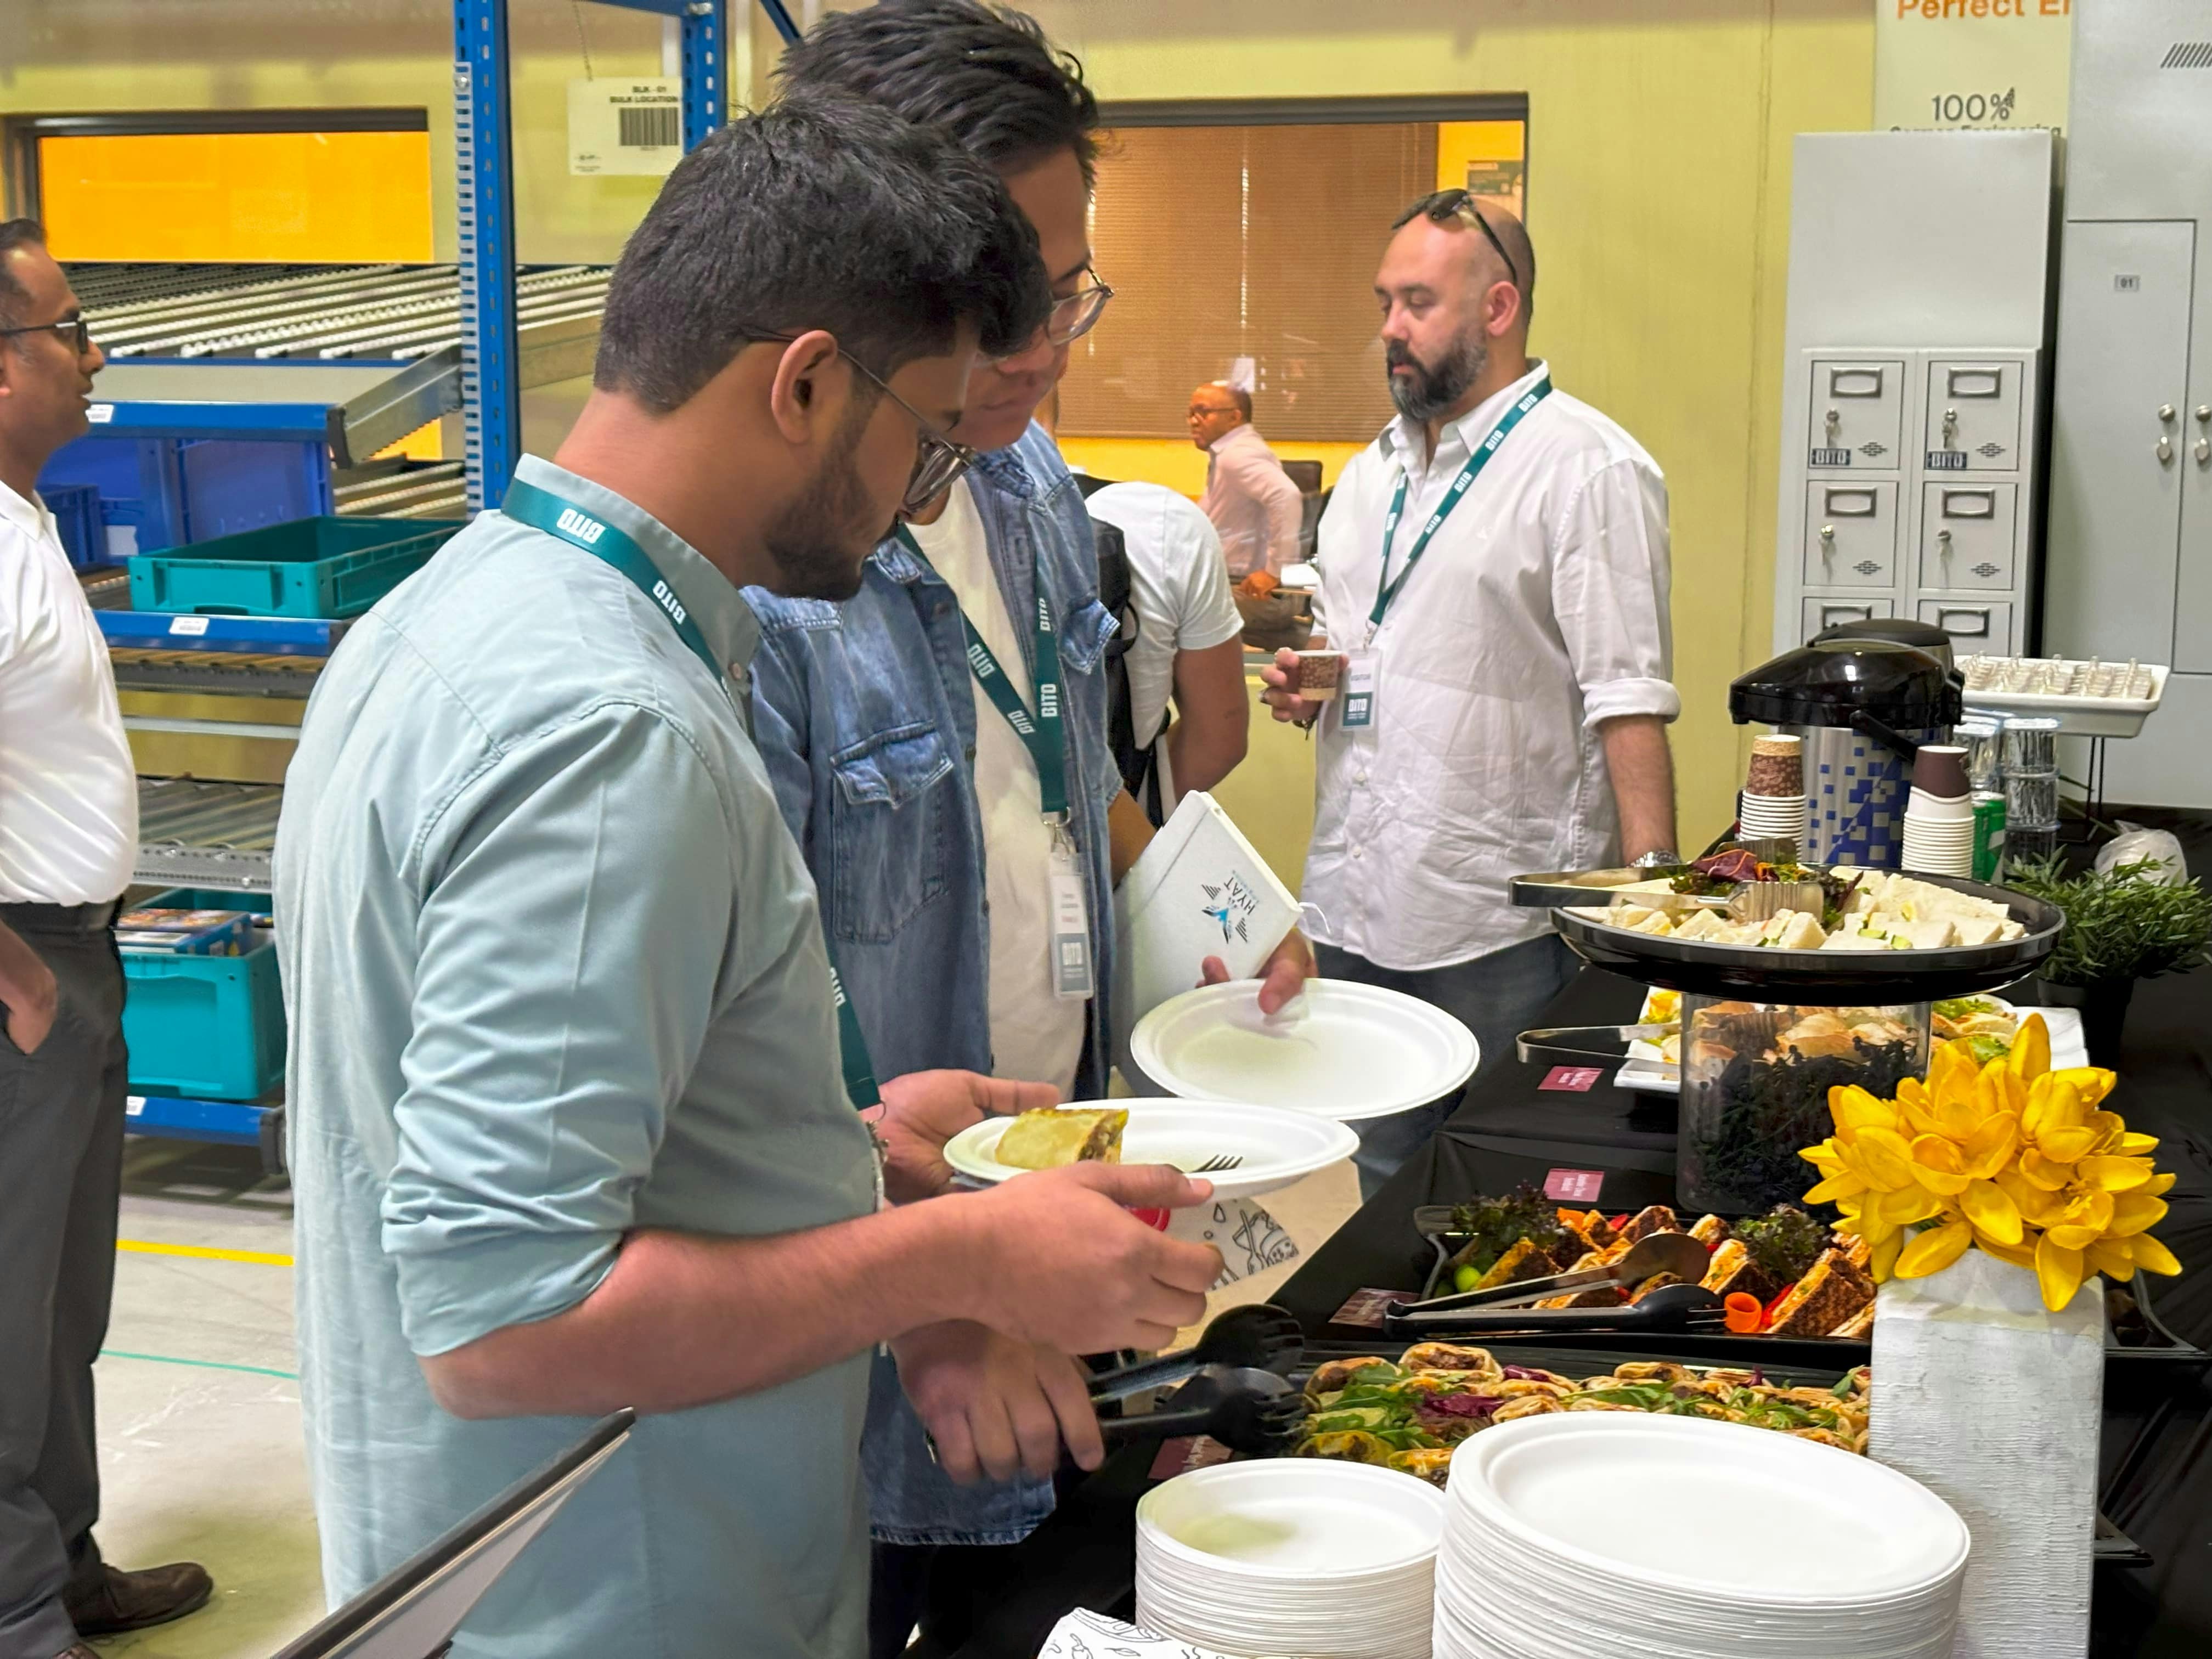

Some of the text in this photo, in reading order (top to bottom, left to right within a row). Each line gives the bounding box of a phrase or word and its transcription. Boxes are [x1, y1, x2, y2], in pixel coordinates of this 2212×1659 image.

[1897, 0, 2025, 19] Perfect
[1932, 93, 2010, 121] 100%
[556, 508, 606, 544] BITO
[653, 580, 686, 625] BITO
[1040, 684, 1058, 718] BITO
[1224, 877, 1255, 915] HYAT
